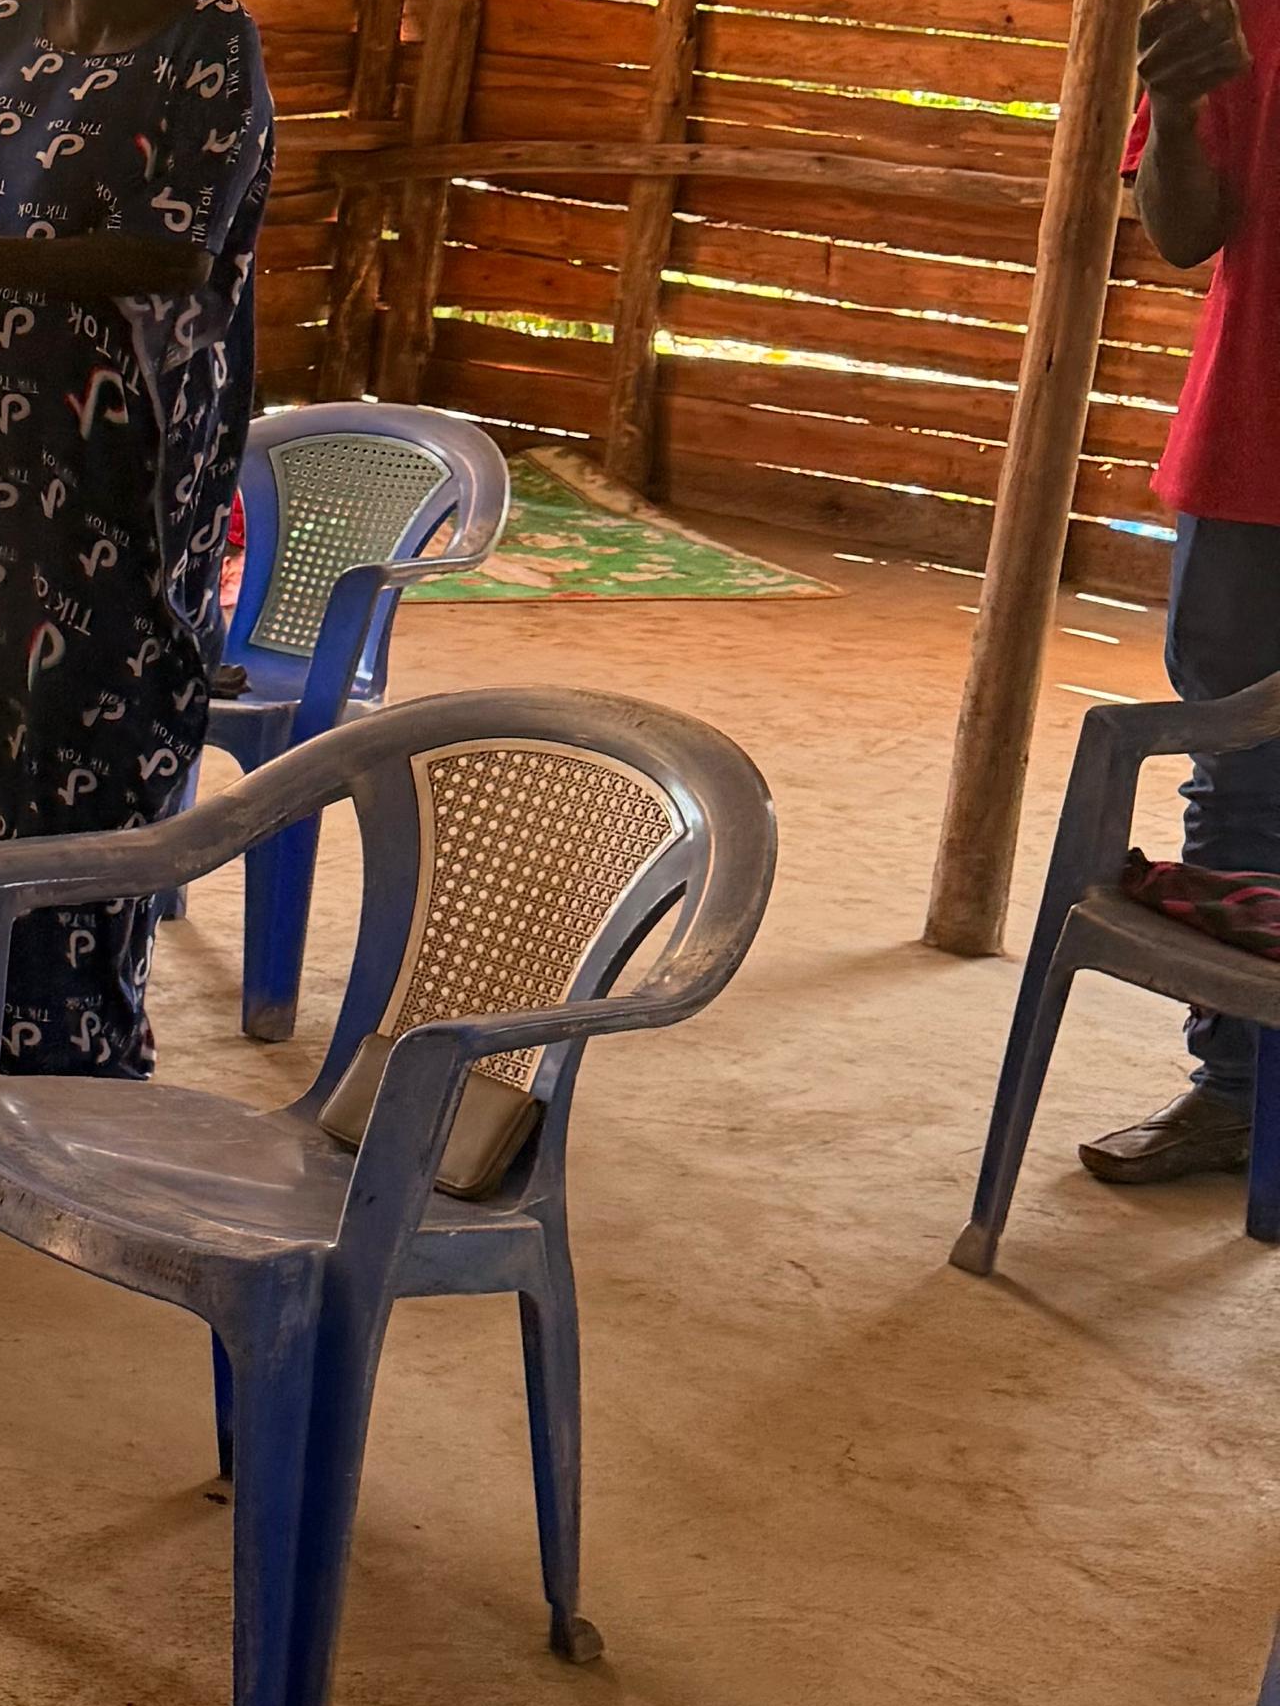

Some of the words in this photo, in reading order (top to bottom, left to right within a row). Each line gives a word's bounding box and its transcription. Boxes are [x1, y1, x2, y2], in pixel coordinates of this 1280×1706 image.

[81, 57, 108, 69] Tok
[112, 53, 135, 67] Tik
[17, 100, 38, 118] Tik
[47, 119, 73, 132] Tok
[80, 122, 103, 135] Tik
[195, 185, 214, 217] Tok
[17, 202, 41, 218] Tok
[46, 204, 69, 221] Tik
[68, 301, 112, 359] Tok
